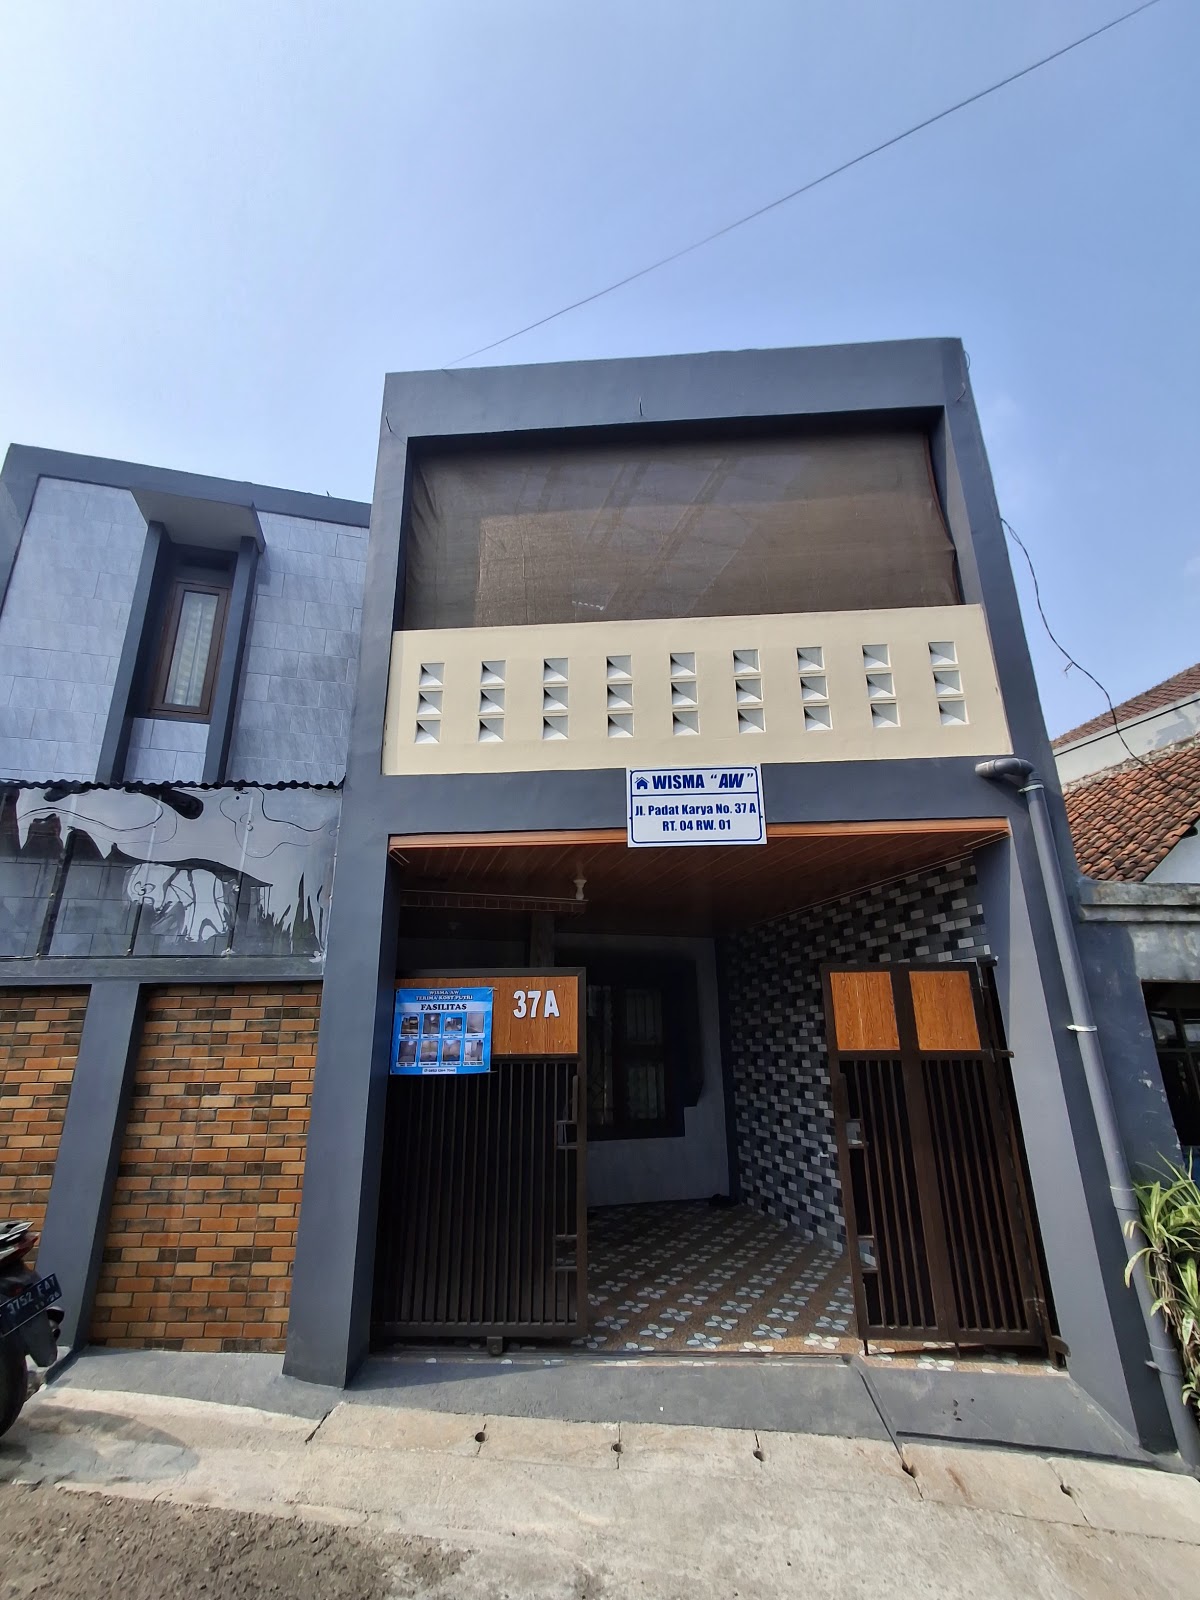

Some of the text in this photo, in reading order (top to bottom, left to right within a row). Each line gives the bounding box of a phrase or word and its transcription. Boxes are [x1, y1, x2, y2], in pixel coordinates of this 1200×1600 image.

[652, 774, 705, 789] WISMA
[648, 805, 679, 815] Padat
[682, 804, 713, 816] Karya
[716, 803, 732, 814] No.
[662, 819, 731, 831] RT. 04 RW. 01
[420, 1003, 467, 1011] FASILITAS
[513, 990, 560, 1018] 37A
[7, 1291, 34, 1315] 3752
